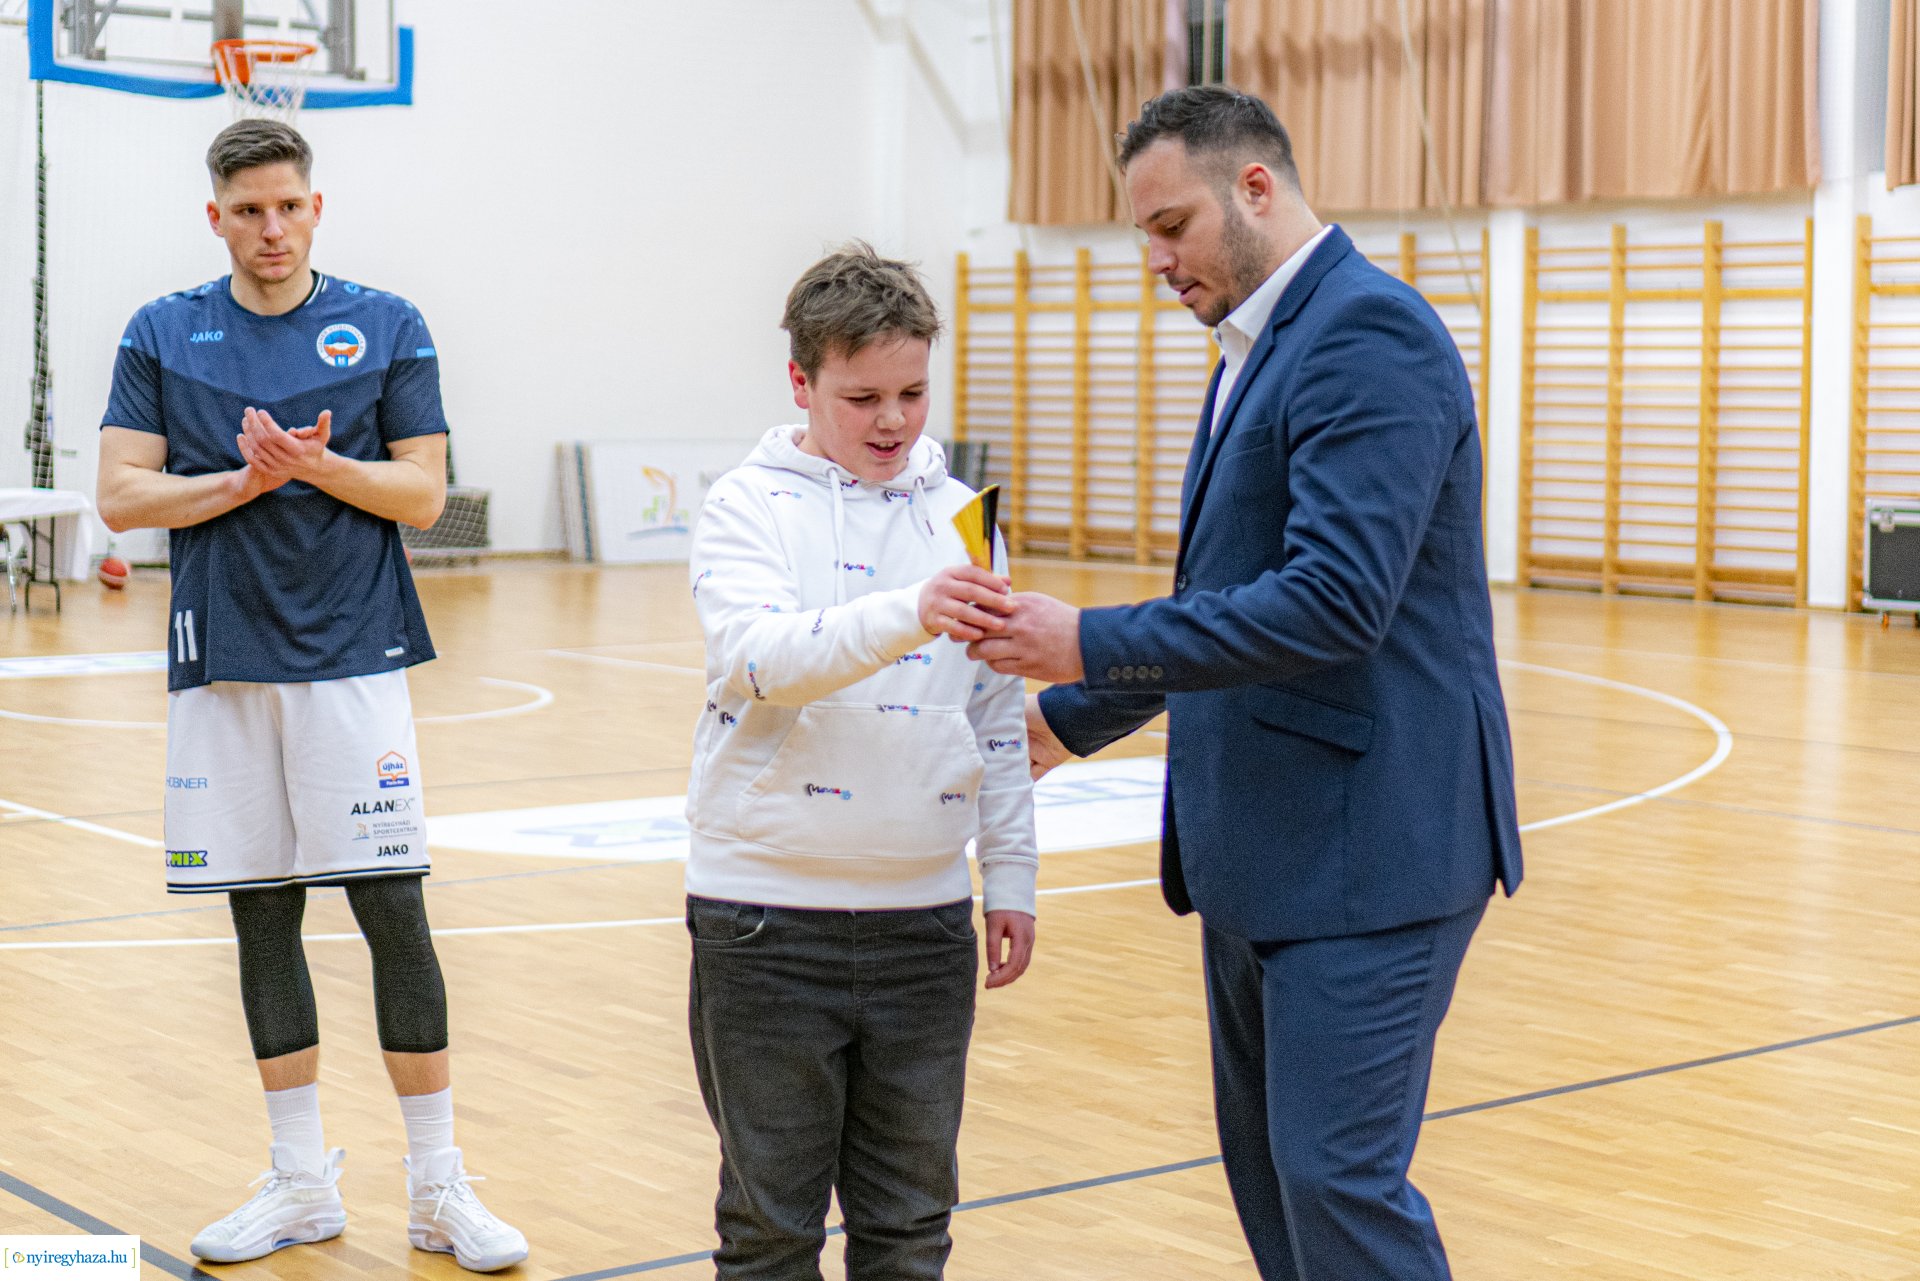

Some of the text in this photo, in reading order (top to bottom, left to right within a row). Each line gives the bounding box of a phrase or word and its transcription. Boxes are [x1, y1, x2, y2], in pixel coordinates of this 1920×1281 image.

[190, 330, 224, 343] JAKO
[174, 609, 198, 663] 11
[382, 761, 404, 771] újház
[350, 798, 411, 815] ALANEX
[376, 844, 409, 857] JAKO
